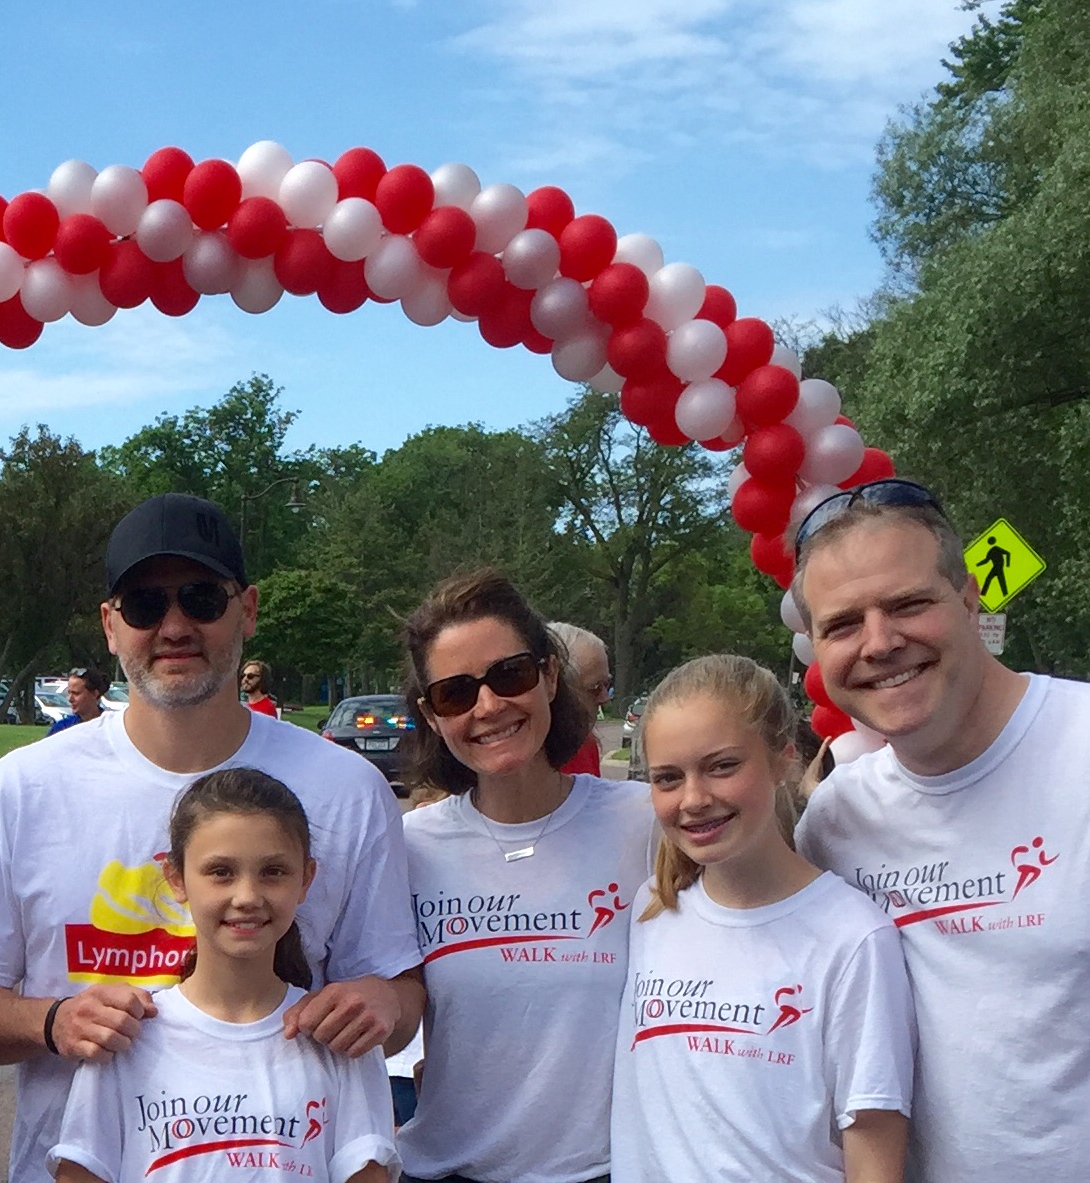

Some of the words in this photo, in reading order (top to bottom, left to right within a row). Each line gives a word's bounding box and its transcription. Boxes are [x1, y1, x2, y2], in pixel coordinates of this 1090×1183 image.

[904, 861, 949, 886] our
[411, 890, 462, 930] Join
[468, 894, 520, 913] our
[934, 915, 985, 936] WALK
[988, 916, 1013, 931] with
[1017, 913, 1046, 928] LRF
[419, 909, 582, 948] Movement
[78, 941, 188, 974] Lympho
[500, 947, 556, 962] WALK
[561, 951, 589, 962] with
[593, 952, 617, 964] LRF
[667, 979, 714, 998] our
[687, 1035, 735, 1056] WALK
[737, 1047, 764, 1059] with
[767, 1050, 796, 1066] LRF
[135, 1090, 189, 1131] Join
[193, 1094, 248, 1114] our
[148, 1114, 300, 1153] Movement
[227, 1152, 280, 1169] WALK
